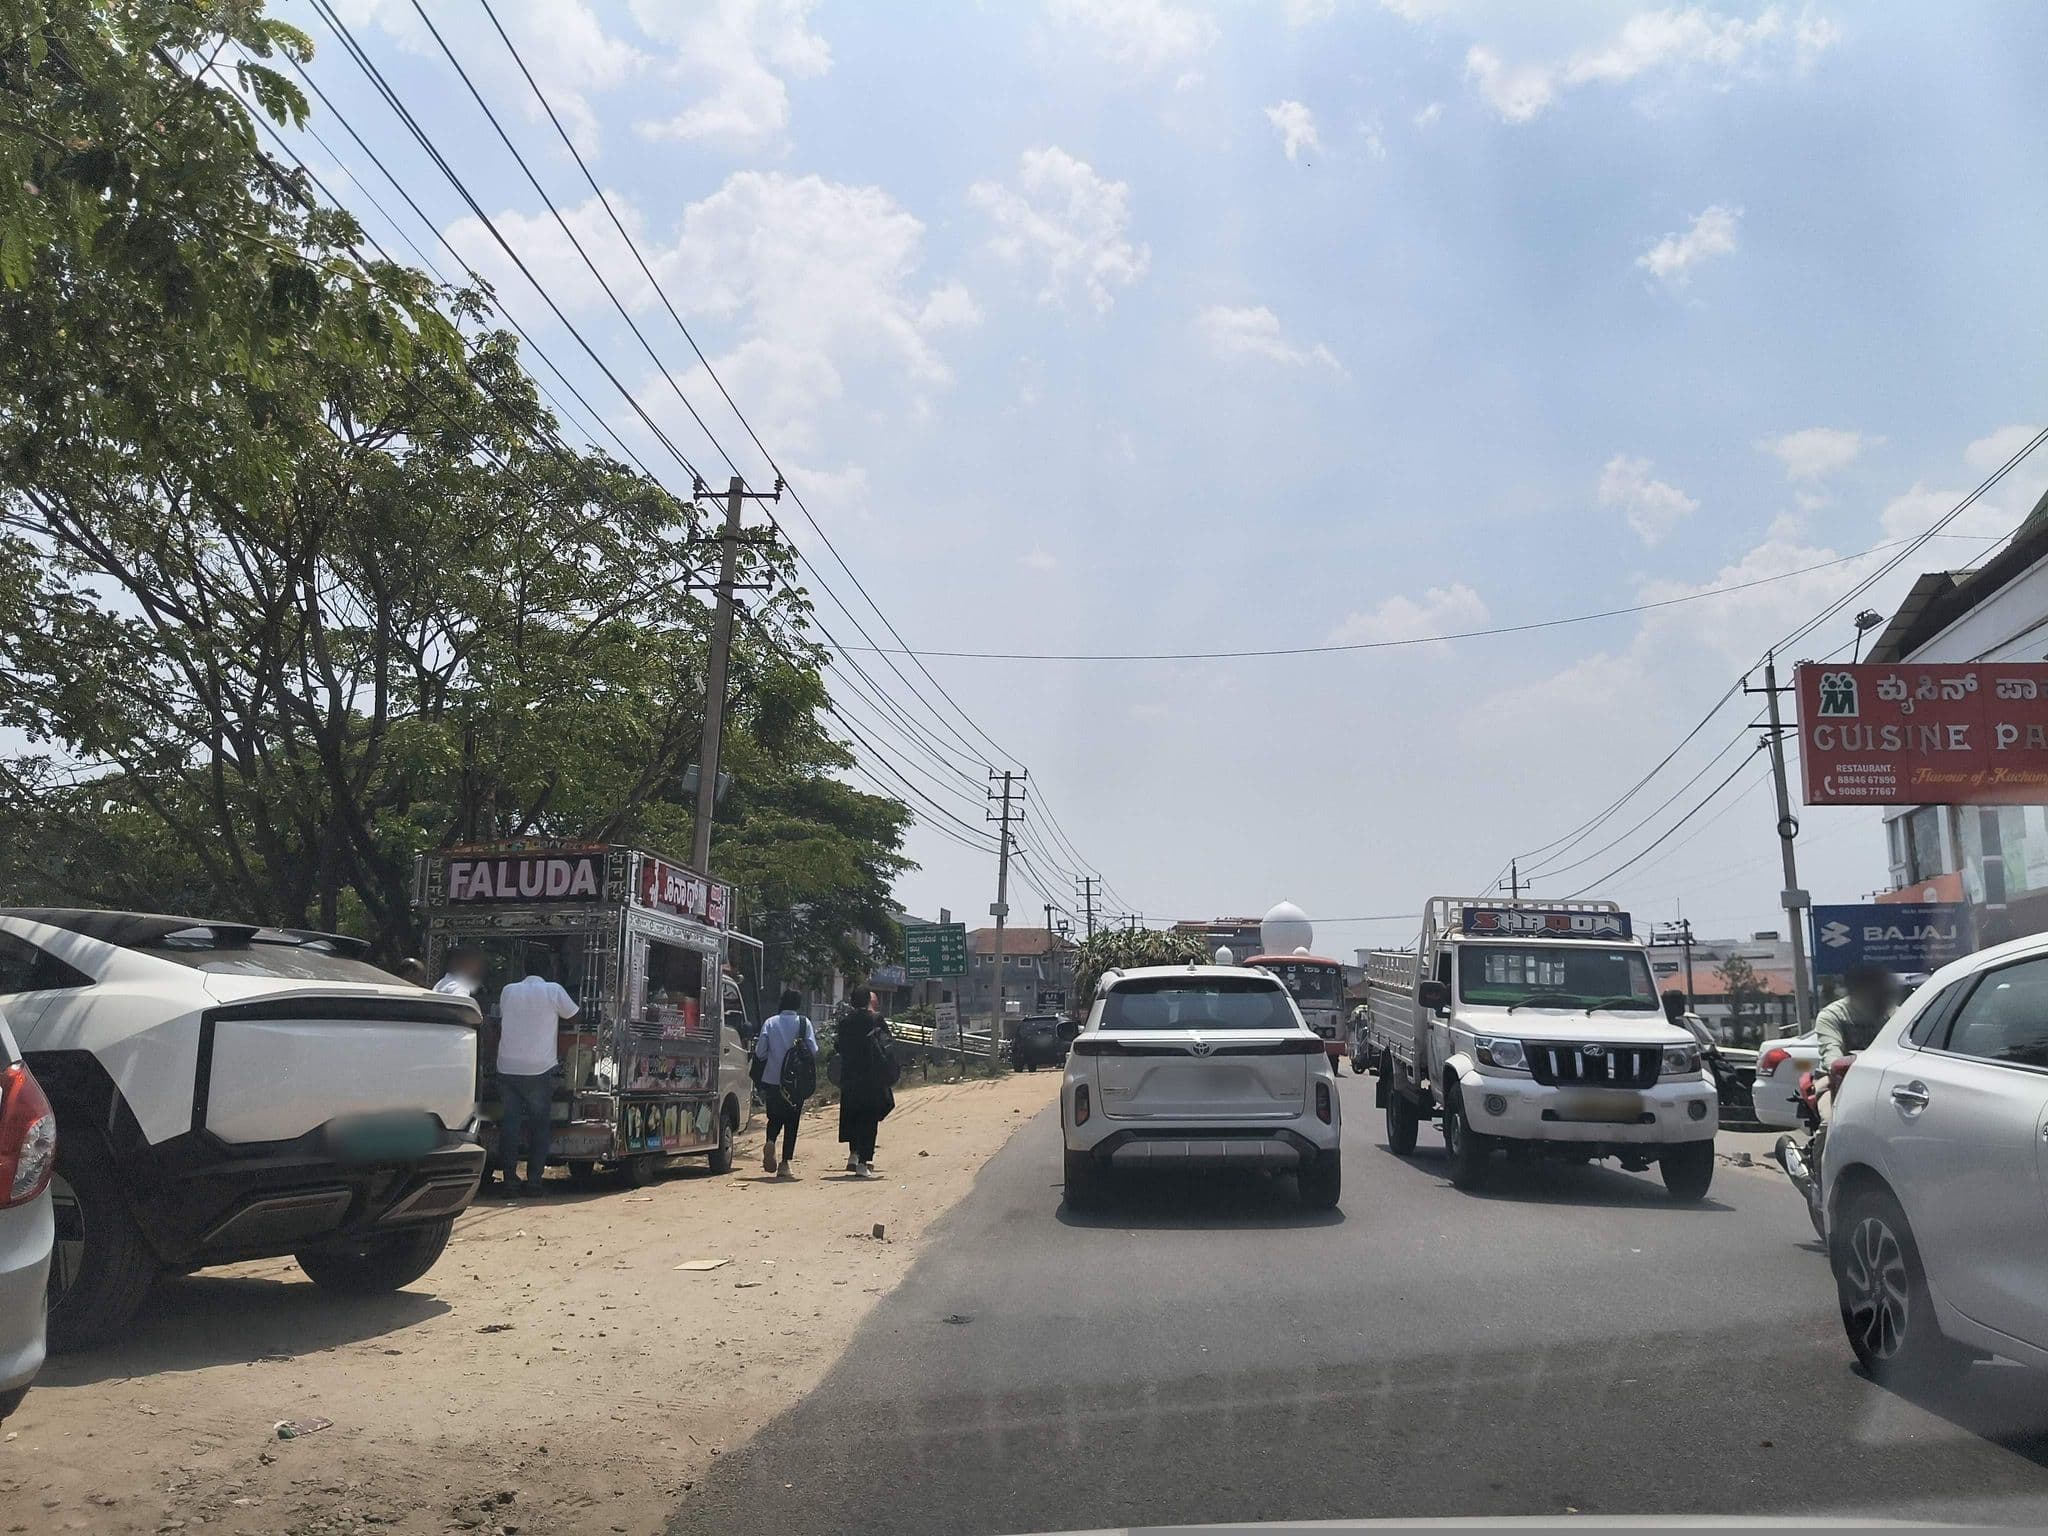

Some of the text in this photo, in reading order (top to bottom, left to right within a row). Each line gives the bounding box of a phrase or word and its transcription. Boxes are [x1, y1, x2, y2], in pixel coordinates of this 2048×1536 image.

[1813, 722, 1972, 756] CUISINE
[1911, 768, 1968, 785] Flavour
[1970, 769, 1987, 786] of
[449, 858, 597, 899] FALUDA
[1471, 910, 1623, 936] SHADOW
[1863, 925, 1957, 941] BAJAJ
